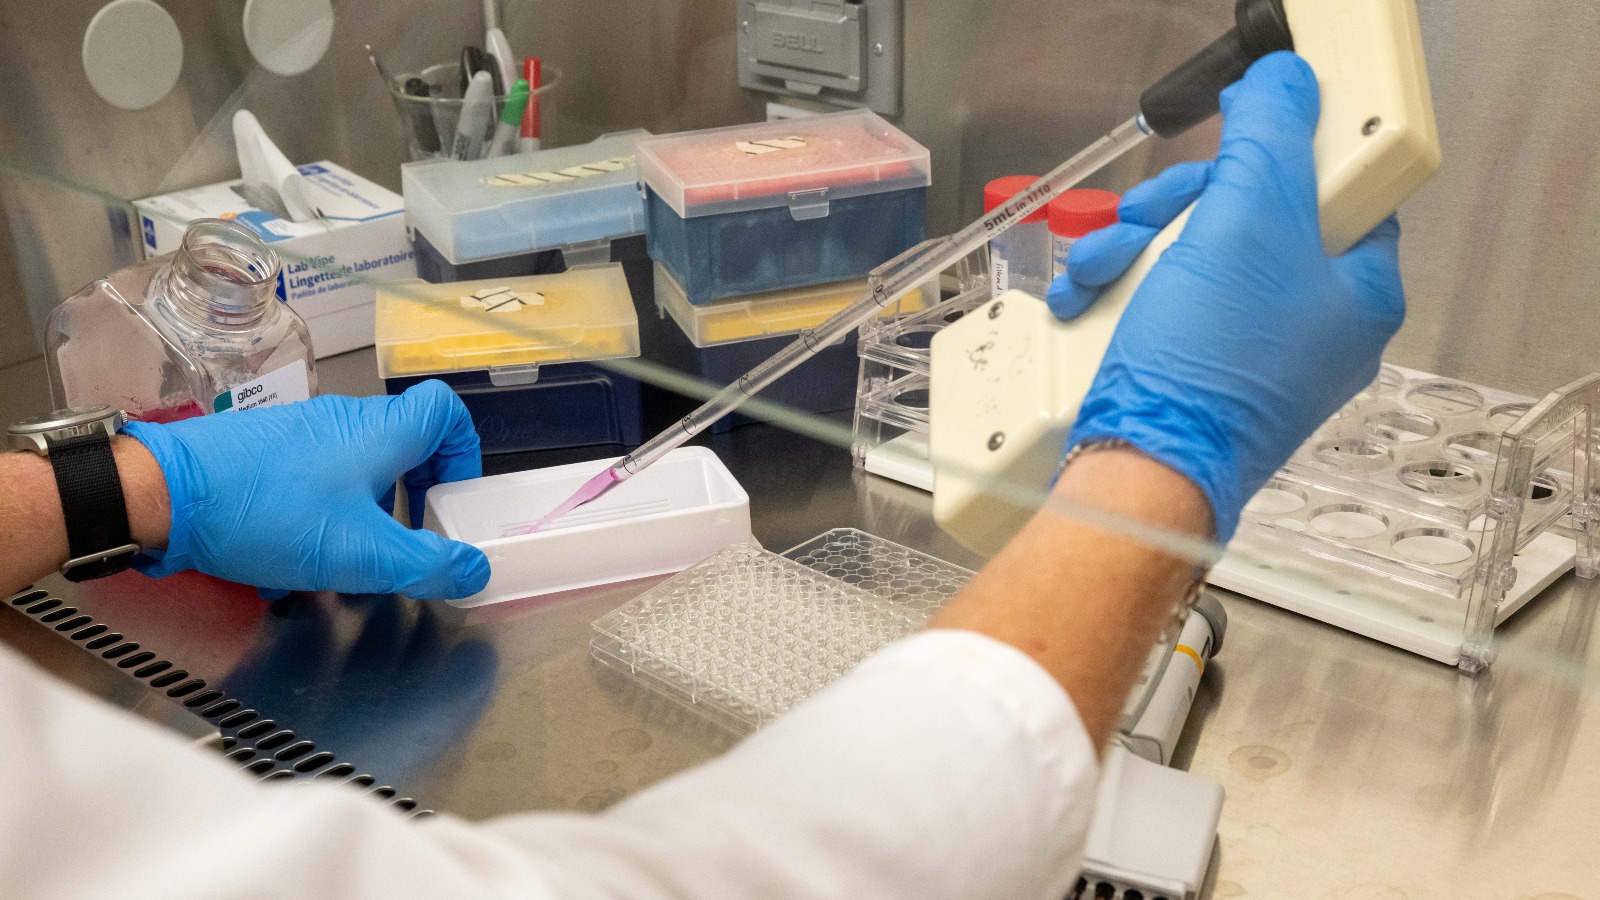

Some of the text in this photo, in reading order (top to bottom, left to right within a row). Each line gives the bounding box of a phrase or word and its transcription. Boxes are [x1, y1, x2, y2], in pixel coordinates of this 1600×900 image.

[771, 31, 824, 54] BELL
[983, 207, 1016, 231] 5mL
[1014, 202, 1028, 211] in
[287, 261, 309, 274] Lab
[289, 271, 341, 288] Lingettes
[238, 385, 262, 402] gibco
